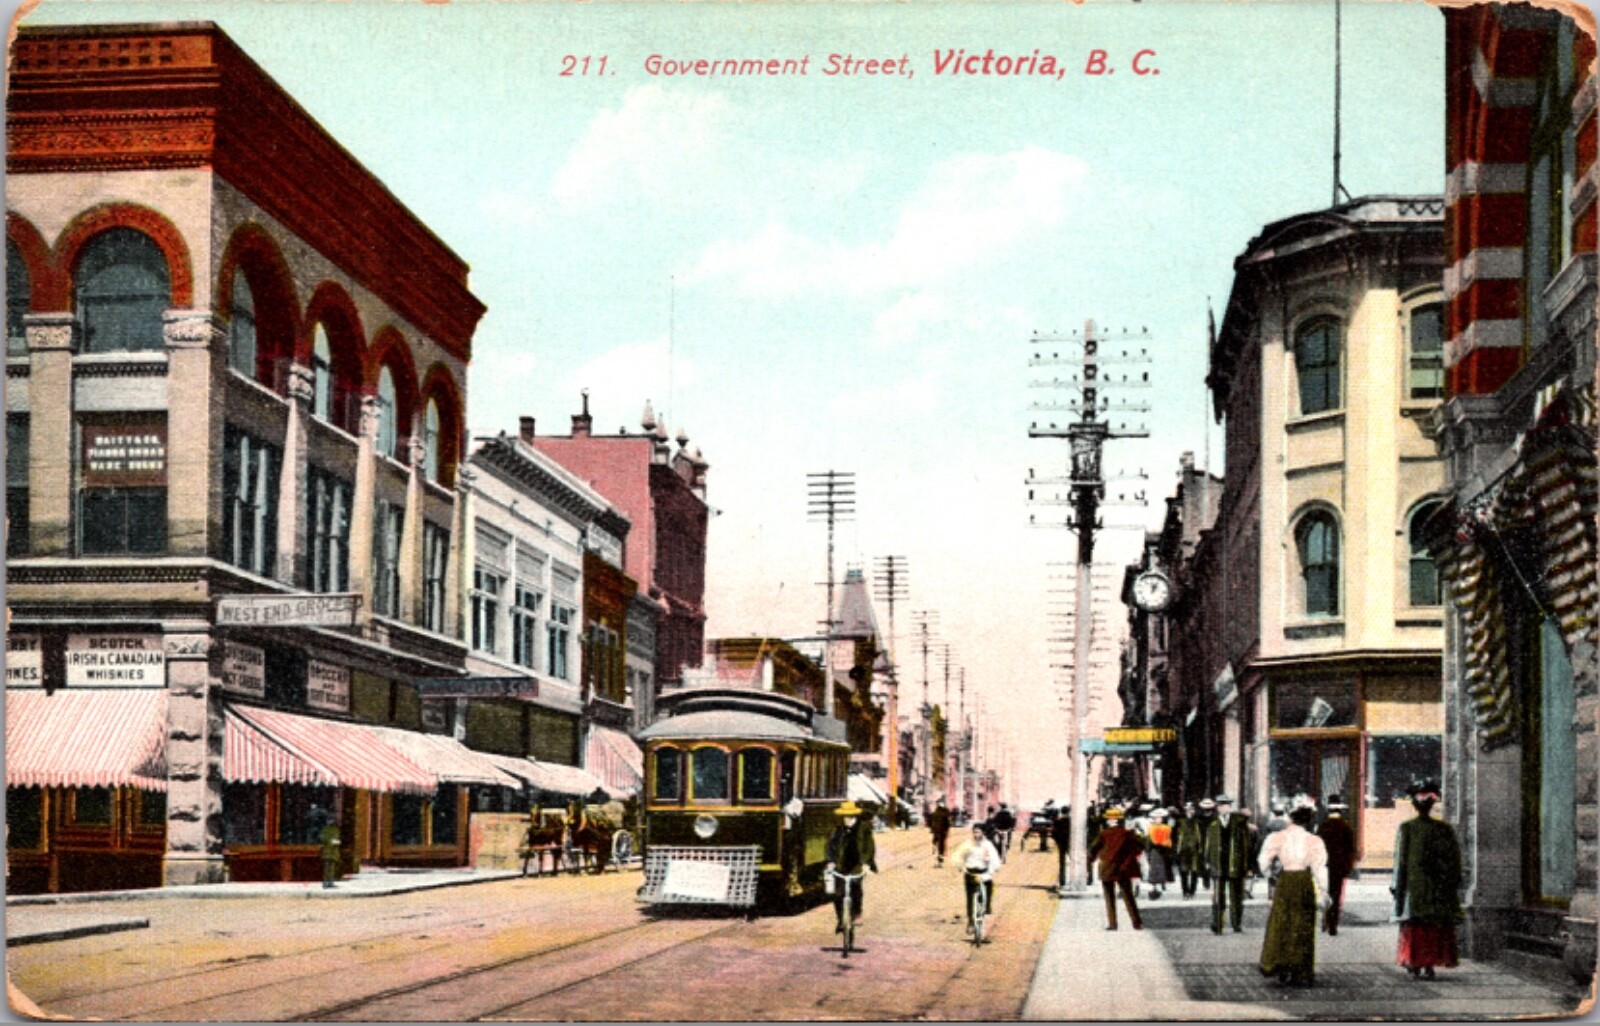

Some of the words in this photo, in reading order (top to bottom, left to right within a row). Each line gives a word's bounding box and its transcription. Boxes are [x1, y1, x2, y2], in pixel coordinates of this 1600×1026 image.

[221, 605, 259, 622] WEST
[263, 602, 291, 624] END
[89, 637, 145, 649] SCOTCH
[68, 653, 98, 665] IRISH
[107, 652, 163, 665] CANADIAN
[86, 668, 145, 680] WHISKIES
